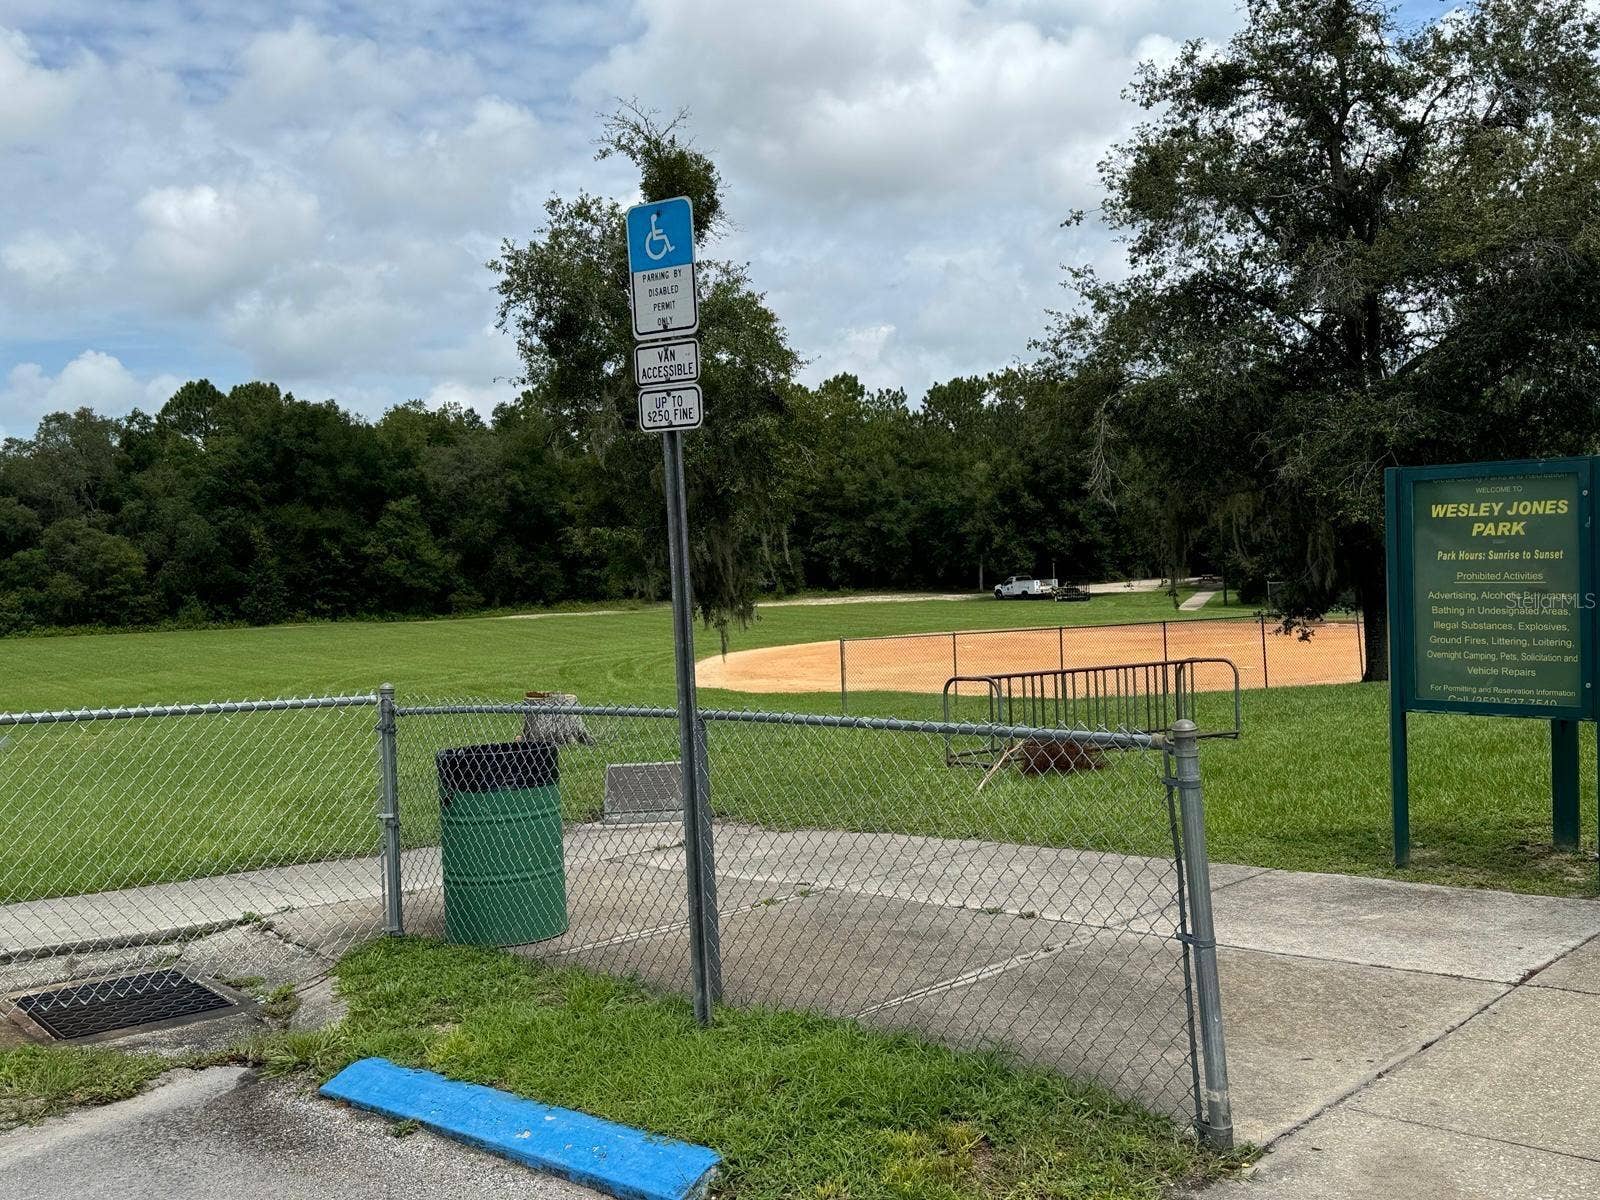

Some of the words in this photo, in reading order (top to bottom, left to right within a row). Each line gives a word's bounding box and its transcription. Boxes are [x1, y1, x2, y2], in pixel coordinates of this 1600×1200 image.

[642, 270, 669, 283] PARKING
[673, 269, 682, 278] BY
[648, 284, 679, 297] DISABLED
[653, 301, 676, 312] PERMIT
[657, 316, 673, 327] ONLY
[657, 350, 676, 362] VAN
[642, 362, 694, 380] ACCESSIBLE
[655, 397, 668, 410] UP
[671, 395, 683, 408] TO
[648, 409, 670, 422] $250
[674, 407, 694, 420] FINE
[1475, 486, 1511, 494] WELCOME
[1431, 502, 1503, 518] WESLEY
[1506, 500, 1569, 516] JONES
[1471, 521, 1528, 537] PARK
[1437, 550, 1456, 560] Park
[1459, 550, 1486, 560] Hours:
[1488, 550, 1519, 560] Sunrise
[1523, 550, 1531, 560] to
[1534, 549, 1564, 559] Sunset
[1456, 571, 1500, 580] Prohibited
[1503, 571, 1544, 580] Activities
[1428, 591, 1479, 601] Advertising,
[1431, 606, 1465, 616] Bathing
[1467, 606, 1475, 614] in
[1478, 606, 1539, 617] Undesignated
[1541, 607, 1571, 616] Areas,
[1433, 621, 1459, 631] Illegal
[1462, 621, 1515, 631] Substances,
[1518, 622, 1570, 632] Explosives,
[1429, 635, 1462, 645] Ground
[1464, 636, 1489, 645] Fires,
[1491, 636, 1530, 648] Littering,
[1533, 637, 1575, 648] Loitering,
[1427, 650, 1462, 660] Overnight
[1463, 651, 1498, 661] Camping,
[1500, 652, 1520, 662] Pets,
[1521, 652, 1561, 662] Solicitation
[1564, 654, 1578, 662] and
[1467, 666, 1498, 675] Vehicle
[1501, 667, 1537, 677] Repairs
[1444, 684, 1477, 694] Permitting
[1493, 687, 1535, 695] Reservation
[1536, 688, 1576, 697] Information
